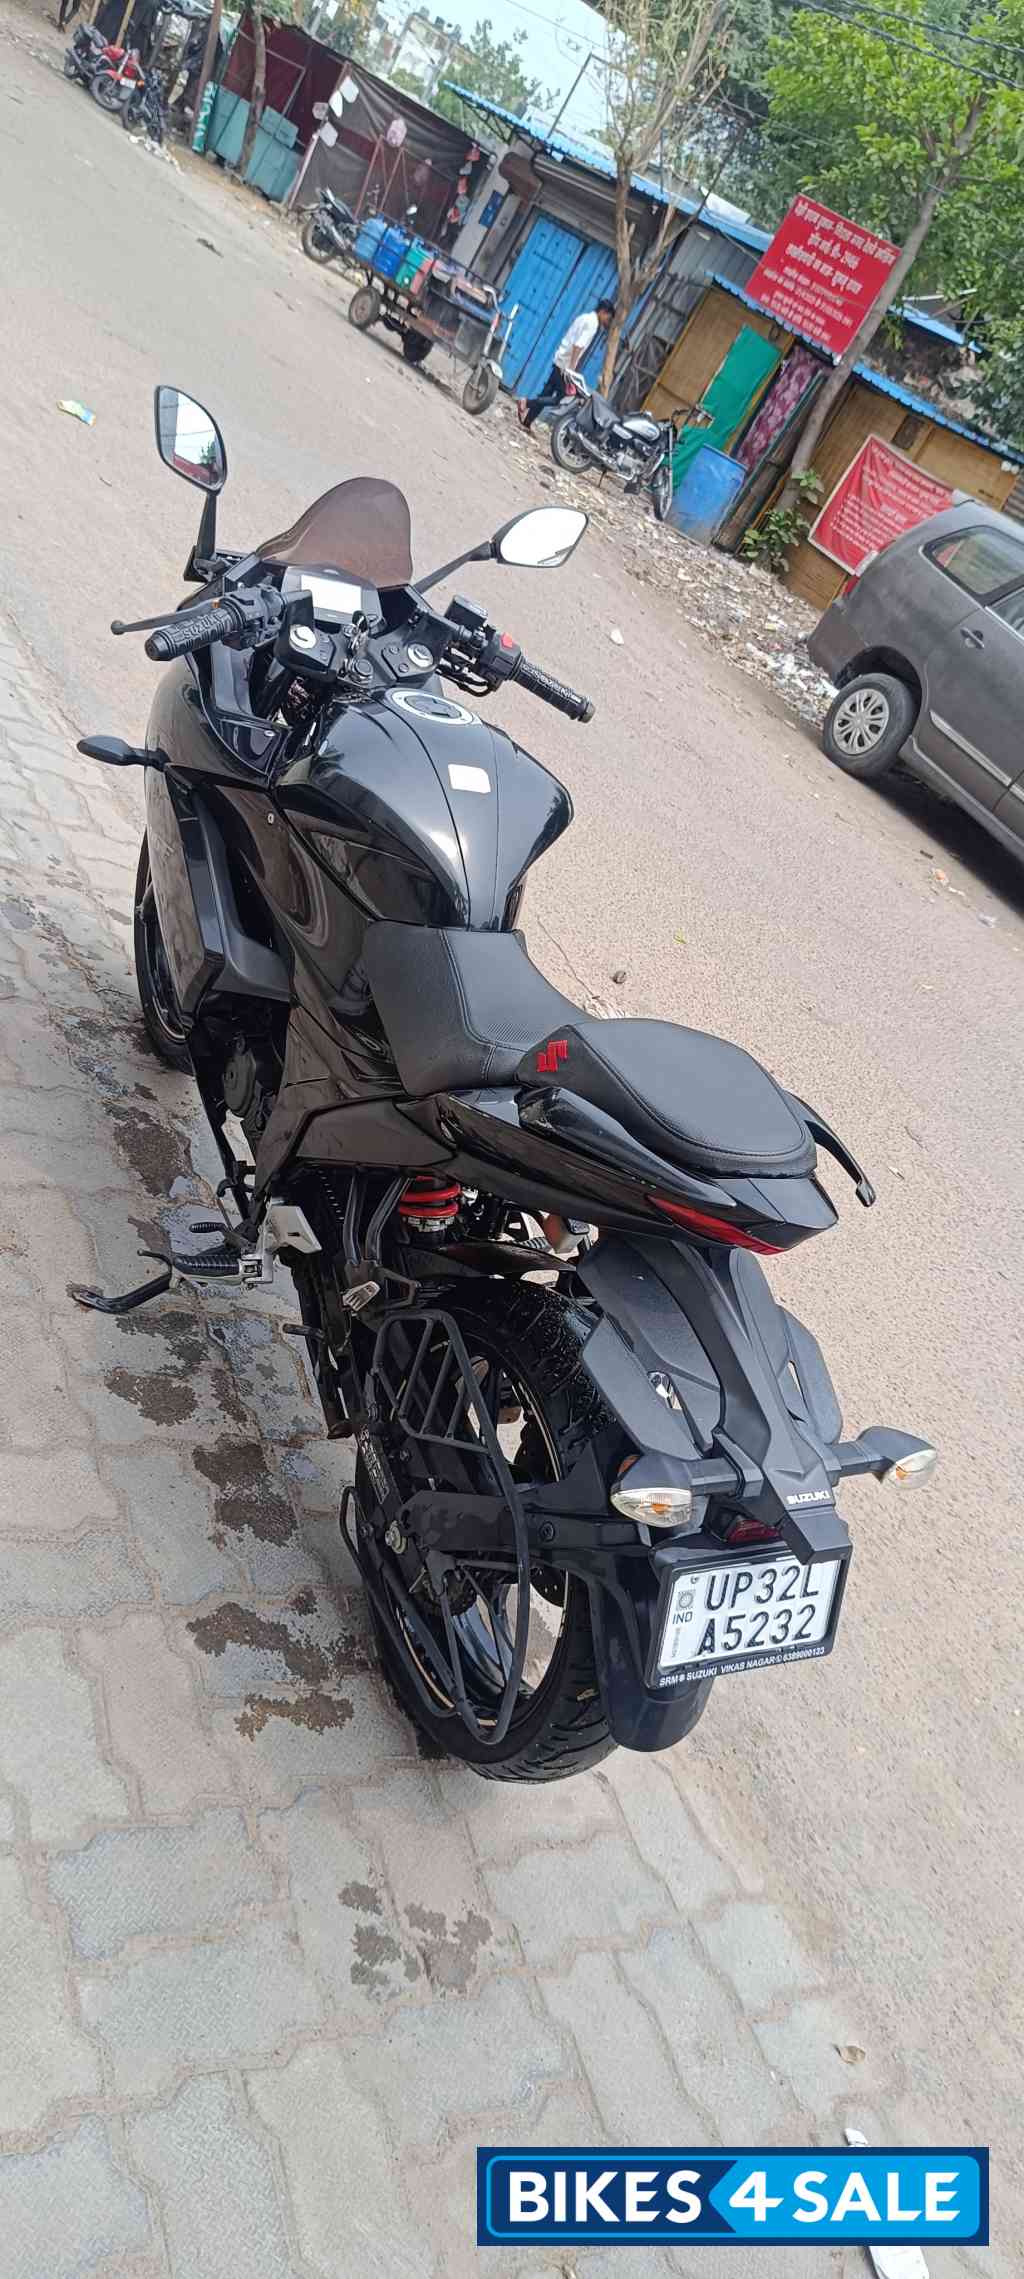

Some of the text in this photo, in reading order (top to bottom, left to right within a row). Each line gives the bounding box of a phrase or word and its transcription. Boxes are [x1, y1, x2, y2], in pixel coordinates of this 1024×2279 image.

[786, 1490, 831, 1505] SUZUKI
[705, 1563, 819, 1611] UP32L
[672, 1611, 693, 1625] IND
[696, 1603, 816, 1656] A5232
[686, 1666, 718, 1681] SUZUKI
[720, 1660, 745, 1674] VIKAS
